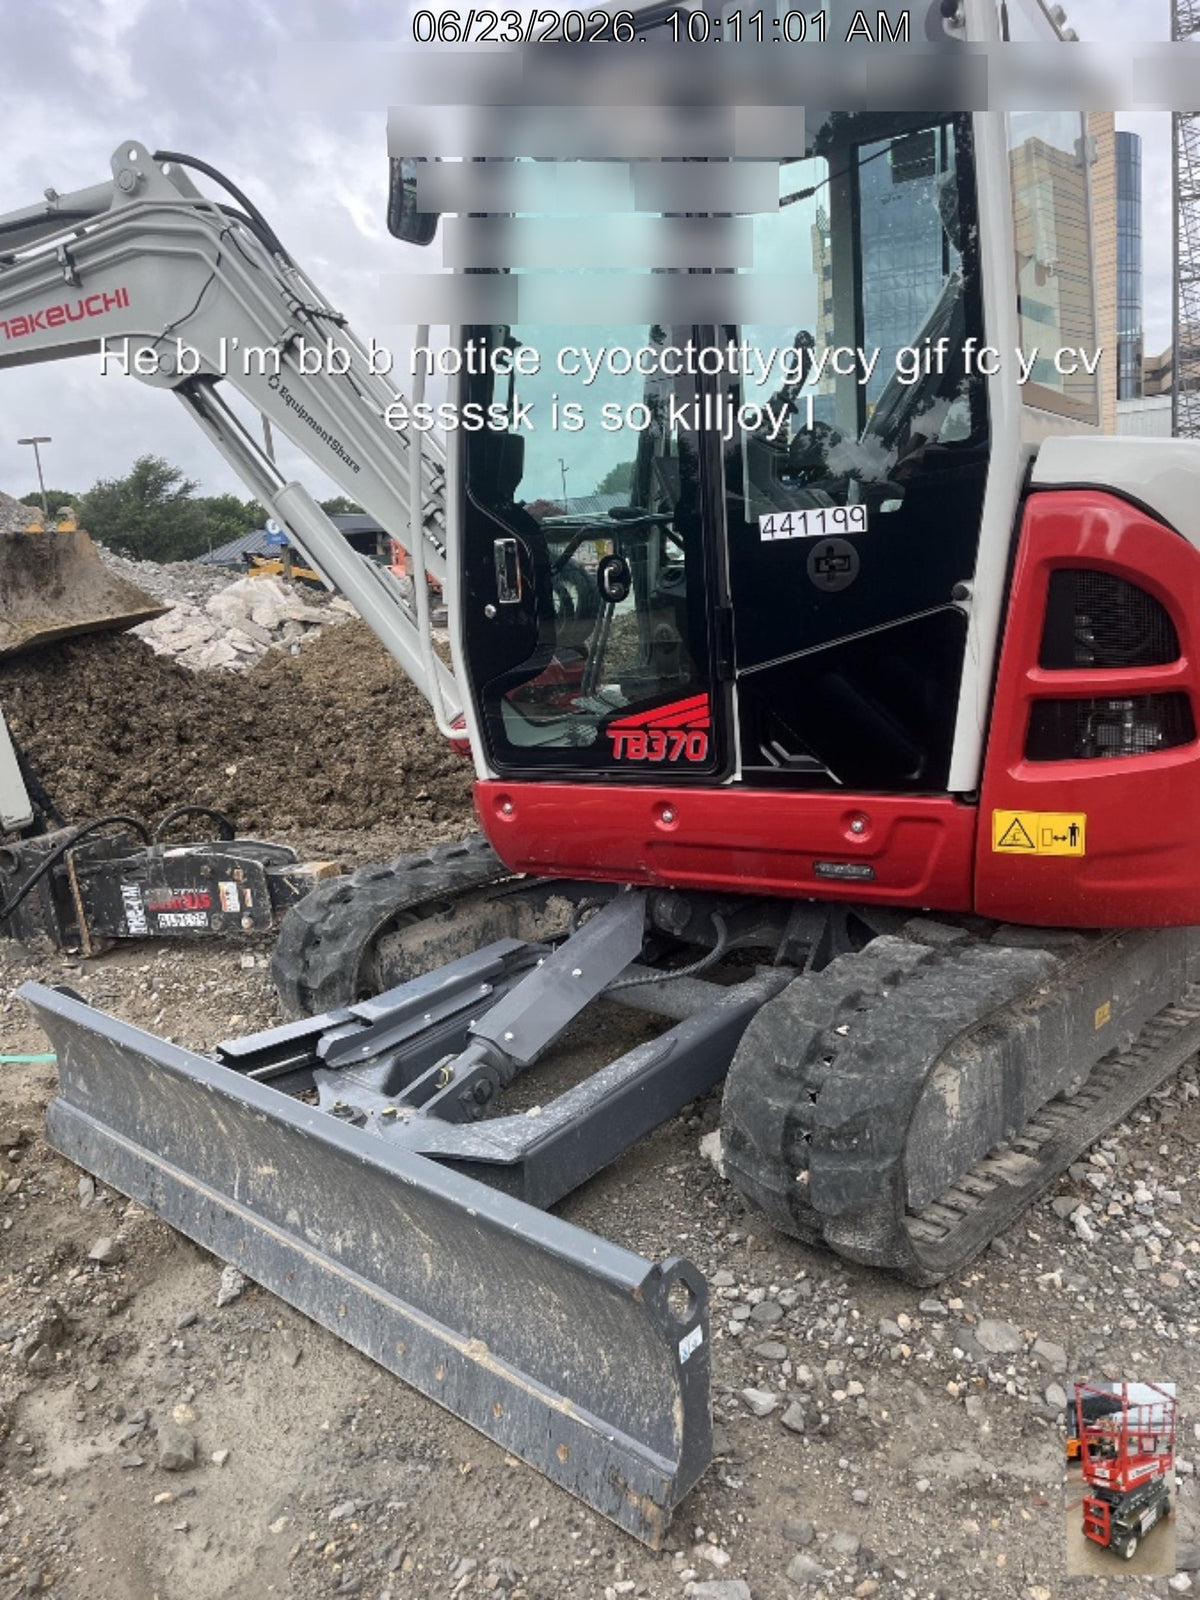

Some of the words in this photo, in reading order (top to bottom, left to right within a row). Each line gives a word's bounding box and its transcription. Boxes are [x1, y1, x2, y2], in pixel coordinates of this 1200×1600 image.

[279, 385, 360, 474] EquipmentShare
[762, 506, 865, 538] 441199
[606, 730, 708, 762] TB370
